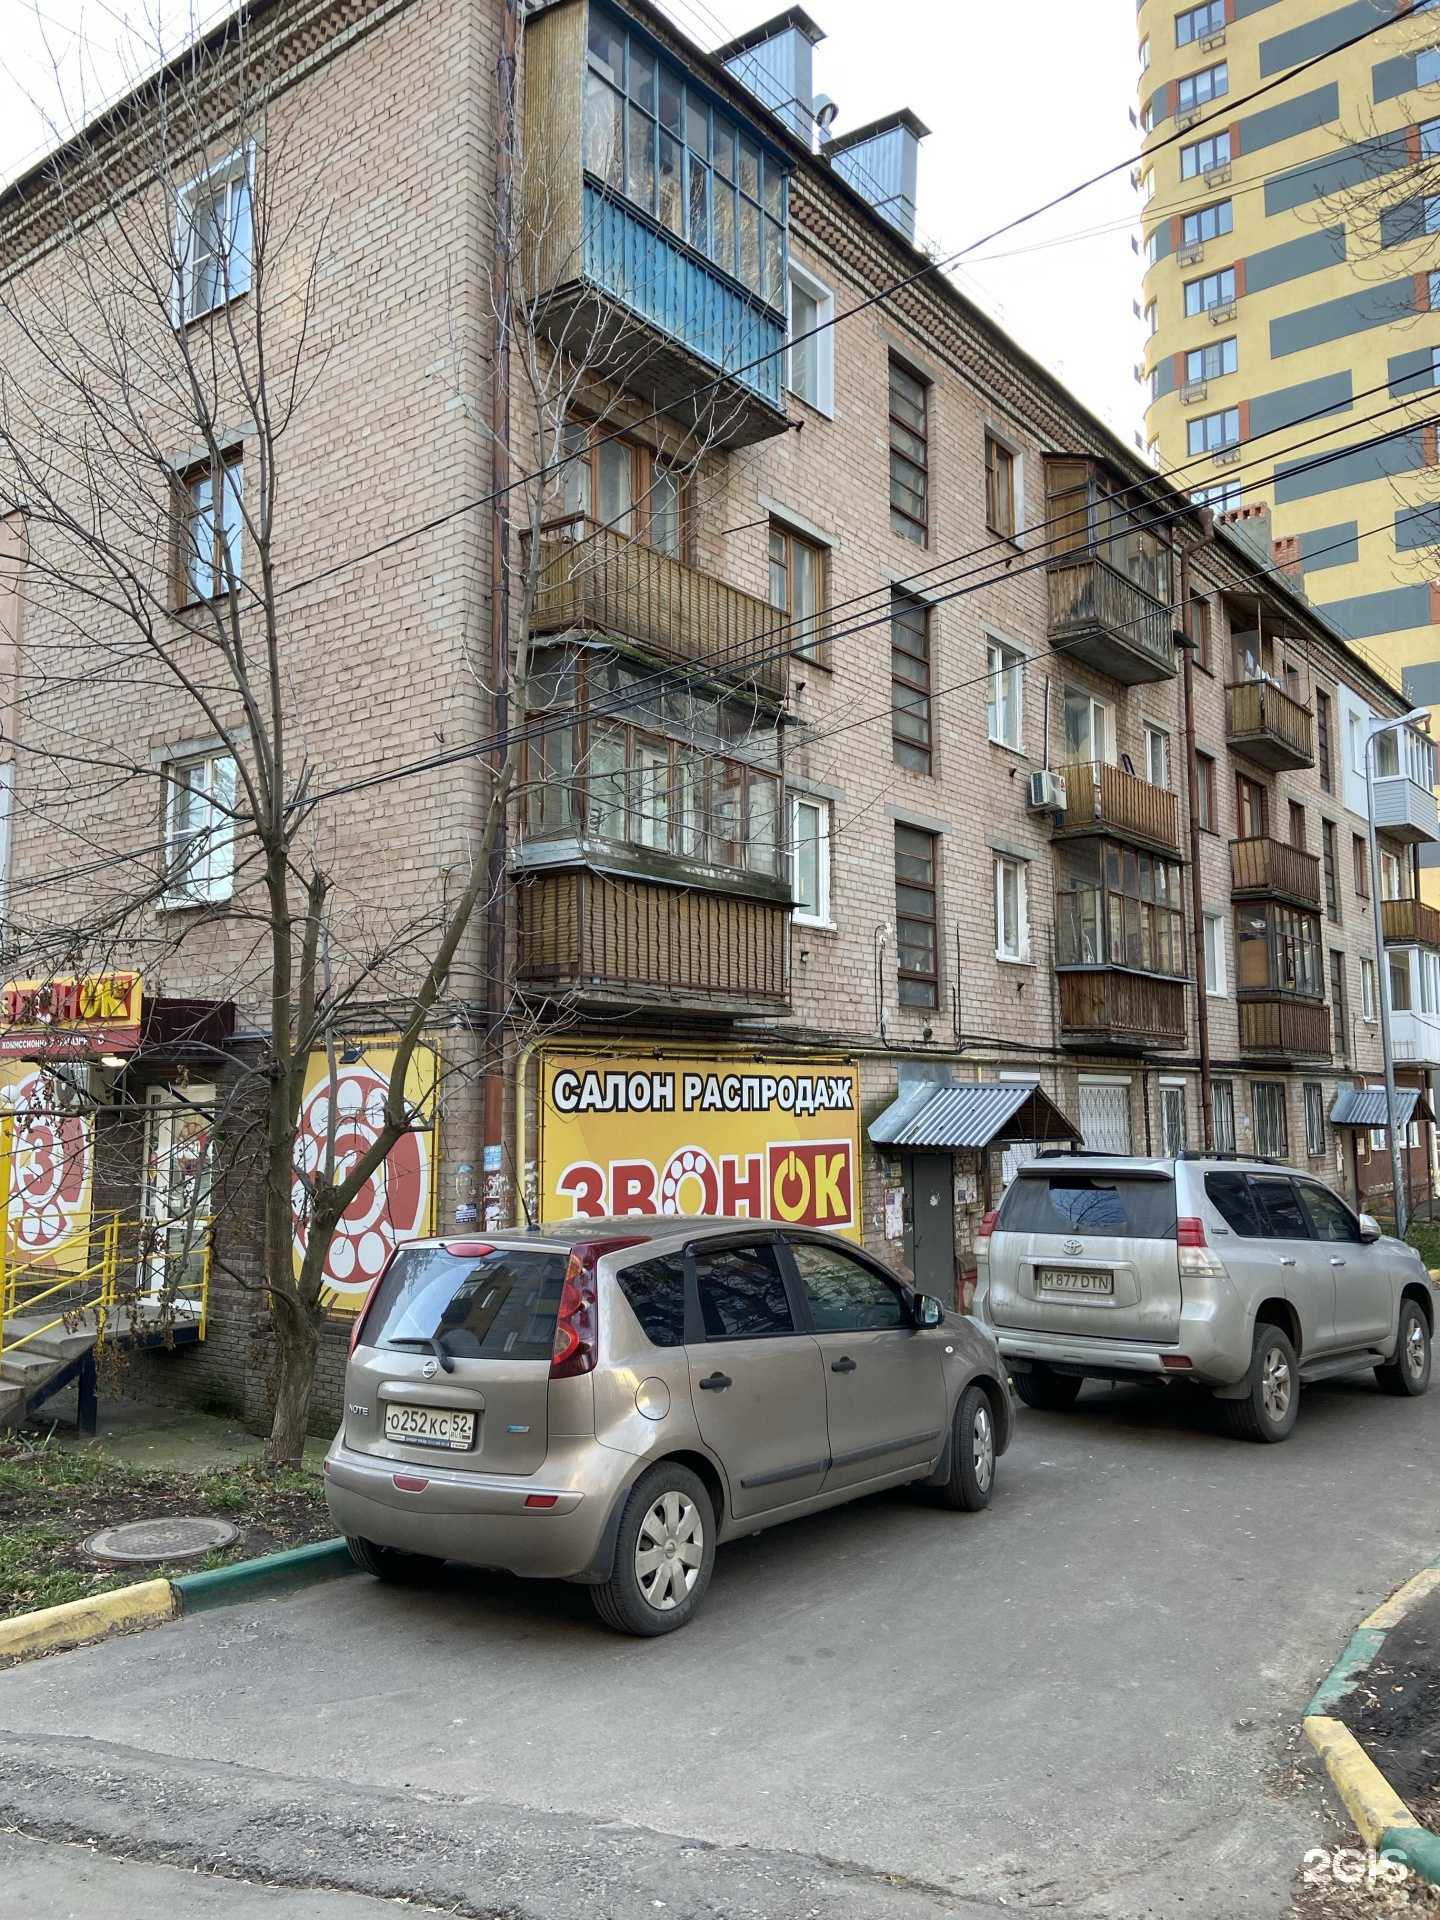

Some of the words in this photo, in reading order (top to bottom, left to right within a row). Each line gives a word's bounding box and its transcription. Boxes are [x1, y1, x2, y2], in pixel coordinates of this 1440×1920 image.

[1, 1037, 54, 1050] КОМИССИОНН
[552, 1069, 675, 1113] САЛОН
[683, 1073, 854, 1117] РАСПРОДАЖ
[556, 1145, 849, 1222] ЗВОНОК
